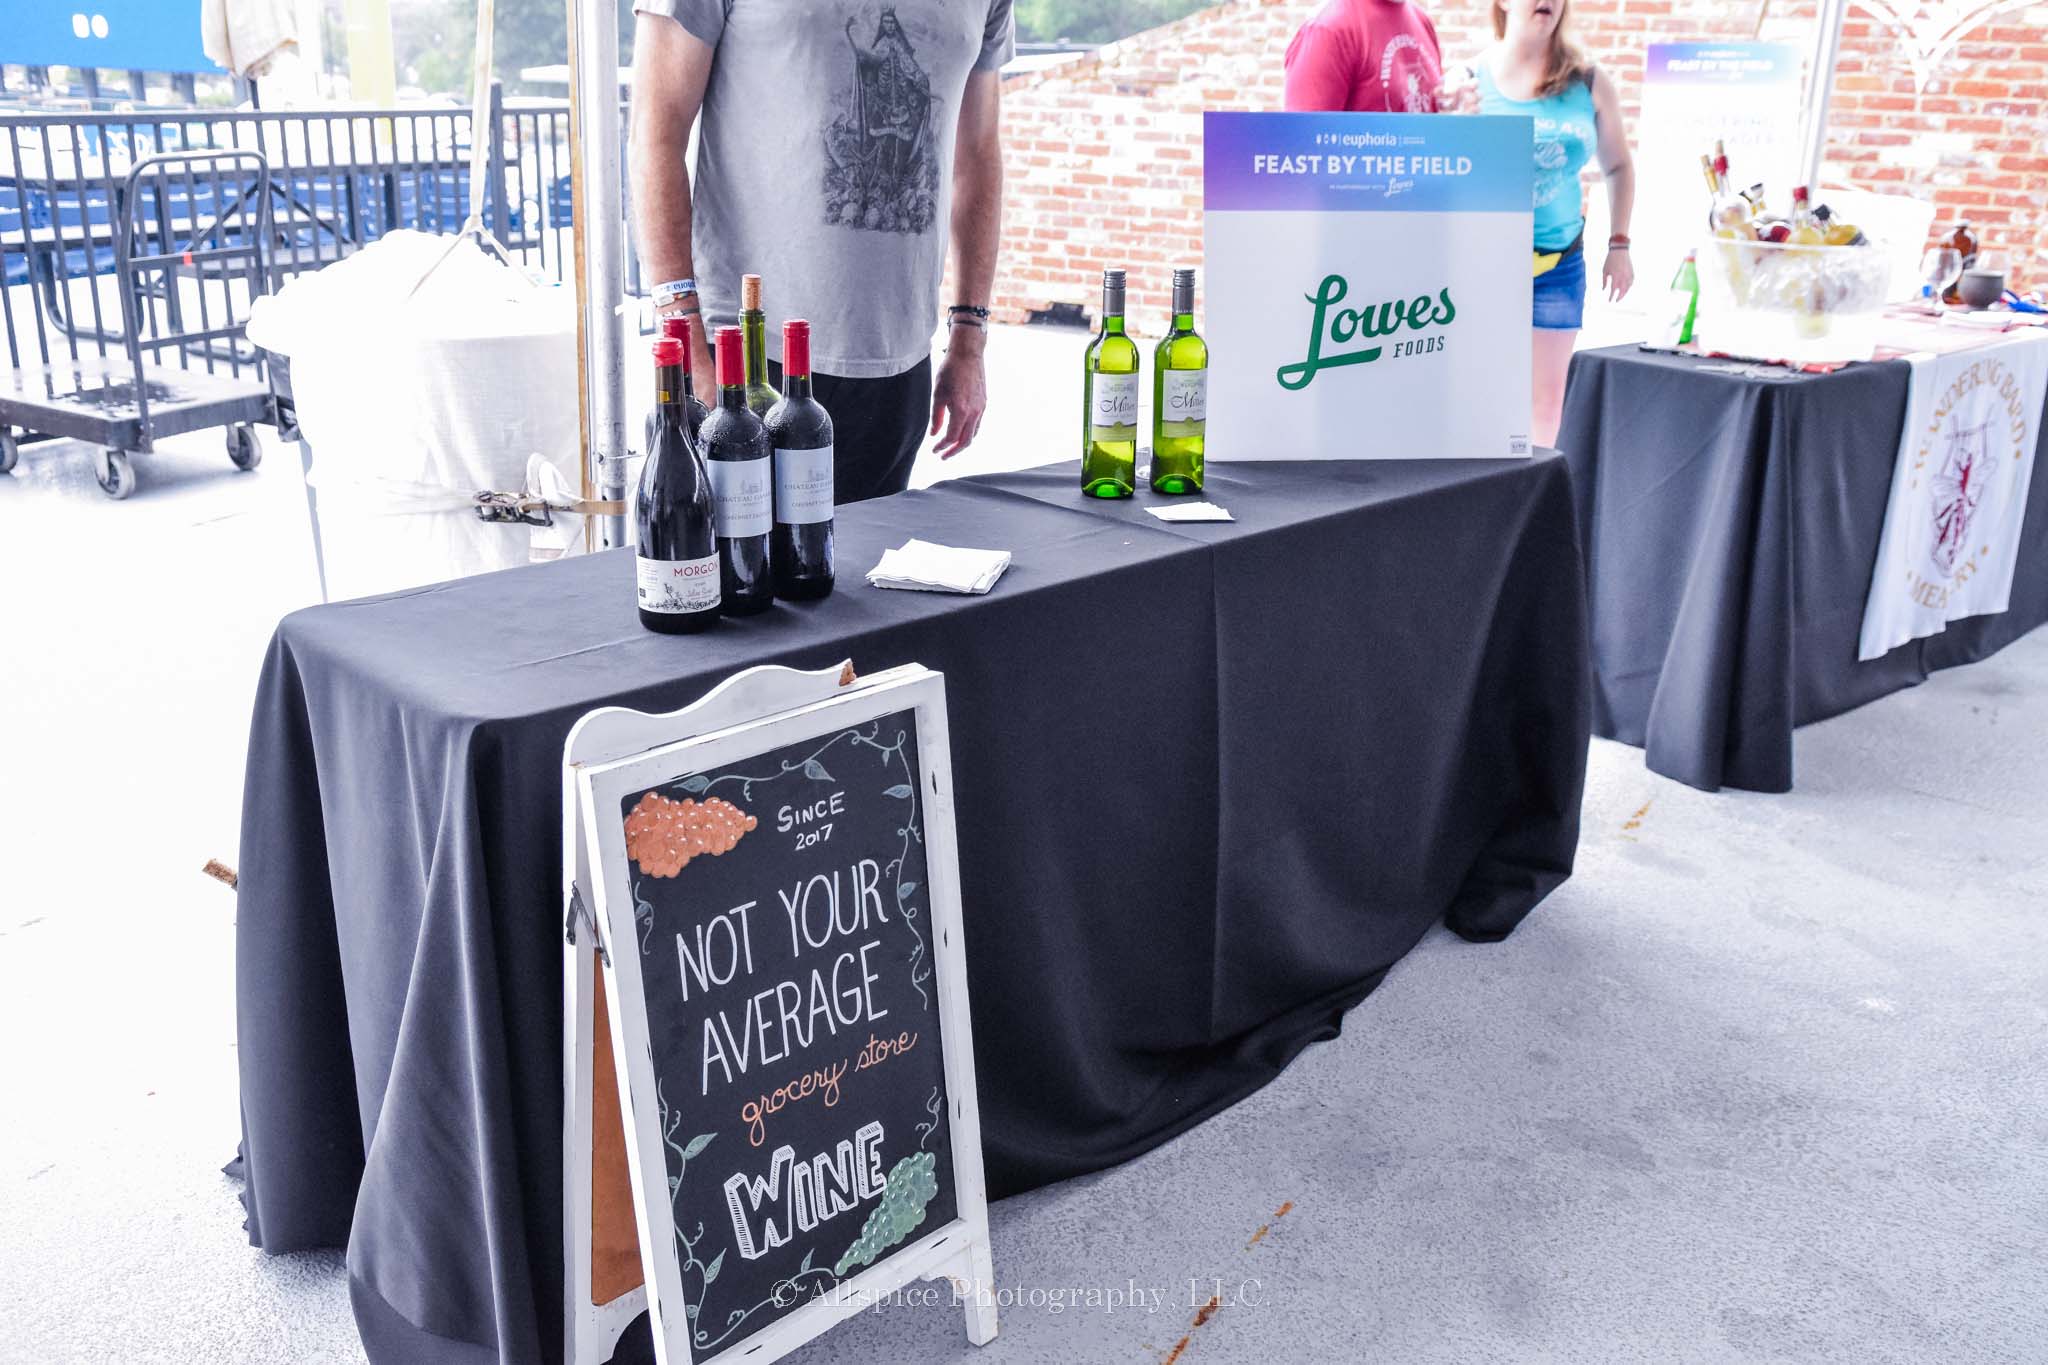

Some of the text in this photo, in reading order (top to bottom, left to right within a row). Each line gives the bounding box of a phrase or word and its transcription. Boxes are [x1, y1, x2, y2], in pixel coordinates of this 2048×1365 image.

[1254, 155, 1472, 176] FEAST BY THE FIELD
[1342, 132, 1397, 149] euphoria
[1277, 274, 1456, 390] Lowes
[1393, 336, 1445, 358] FOODS
[777, 791, 845, 833] SINCE
[795, 824, 834, 851] 2017
[676, 859, 889, 1001] NOT YOUR
[702, 940, 889, 1096] AVERAGE
[742, 1033, 918, 1146] grocery store
[723, 1121, 888, 1260] WINE
